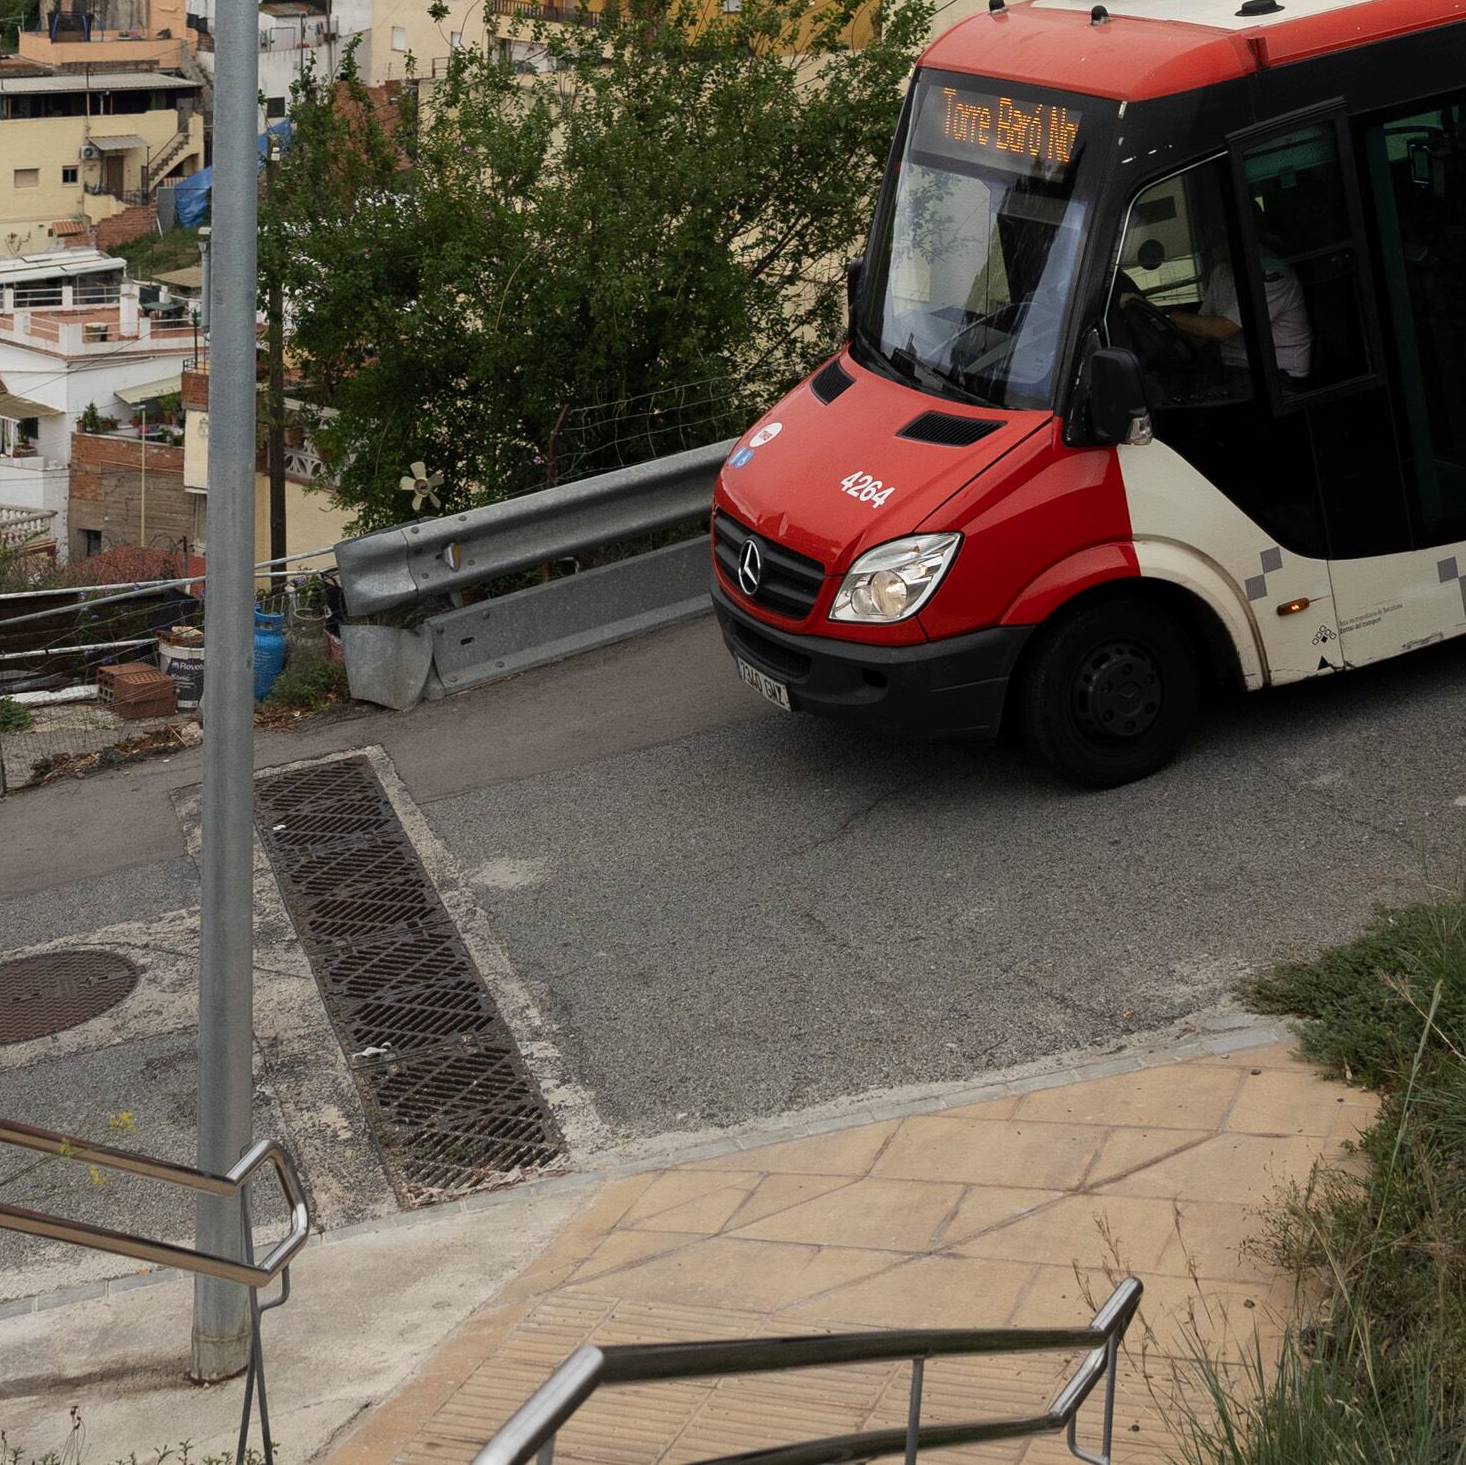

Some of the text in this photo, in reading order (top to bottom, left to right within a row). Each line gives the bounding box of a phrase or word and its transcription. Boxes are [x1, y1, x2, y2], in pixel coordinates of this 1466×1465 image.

[941, 87, 992, 147] Torre
[996, 97, 1043, 157] Baró
[839, 470, 897, 509] 4264
